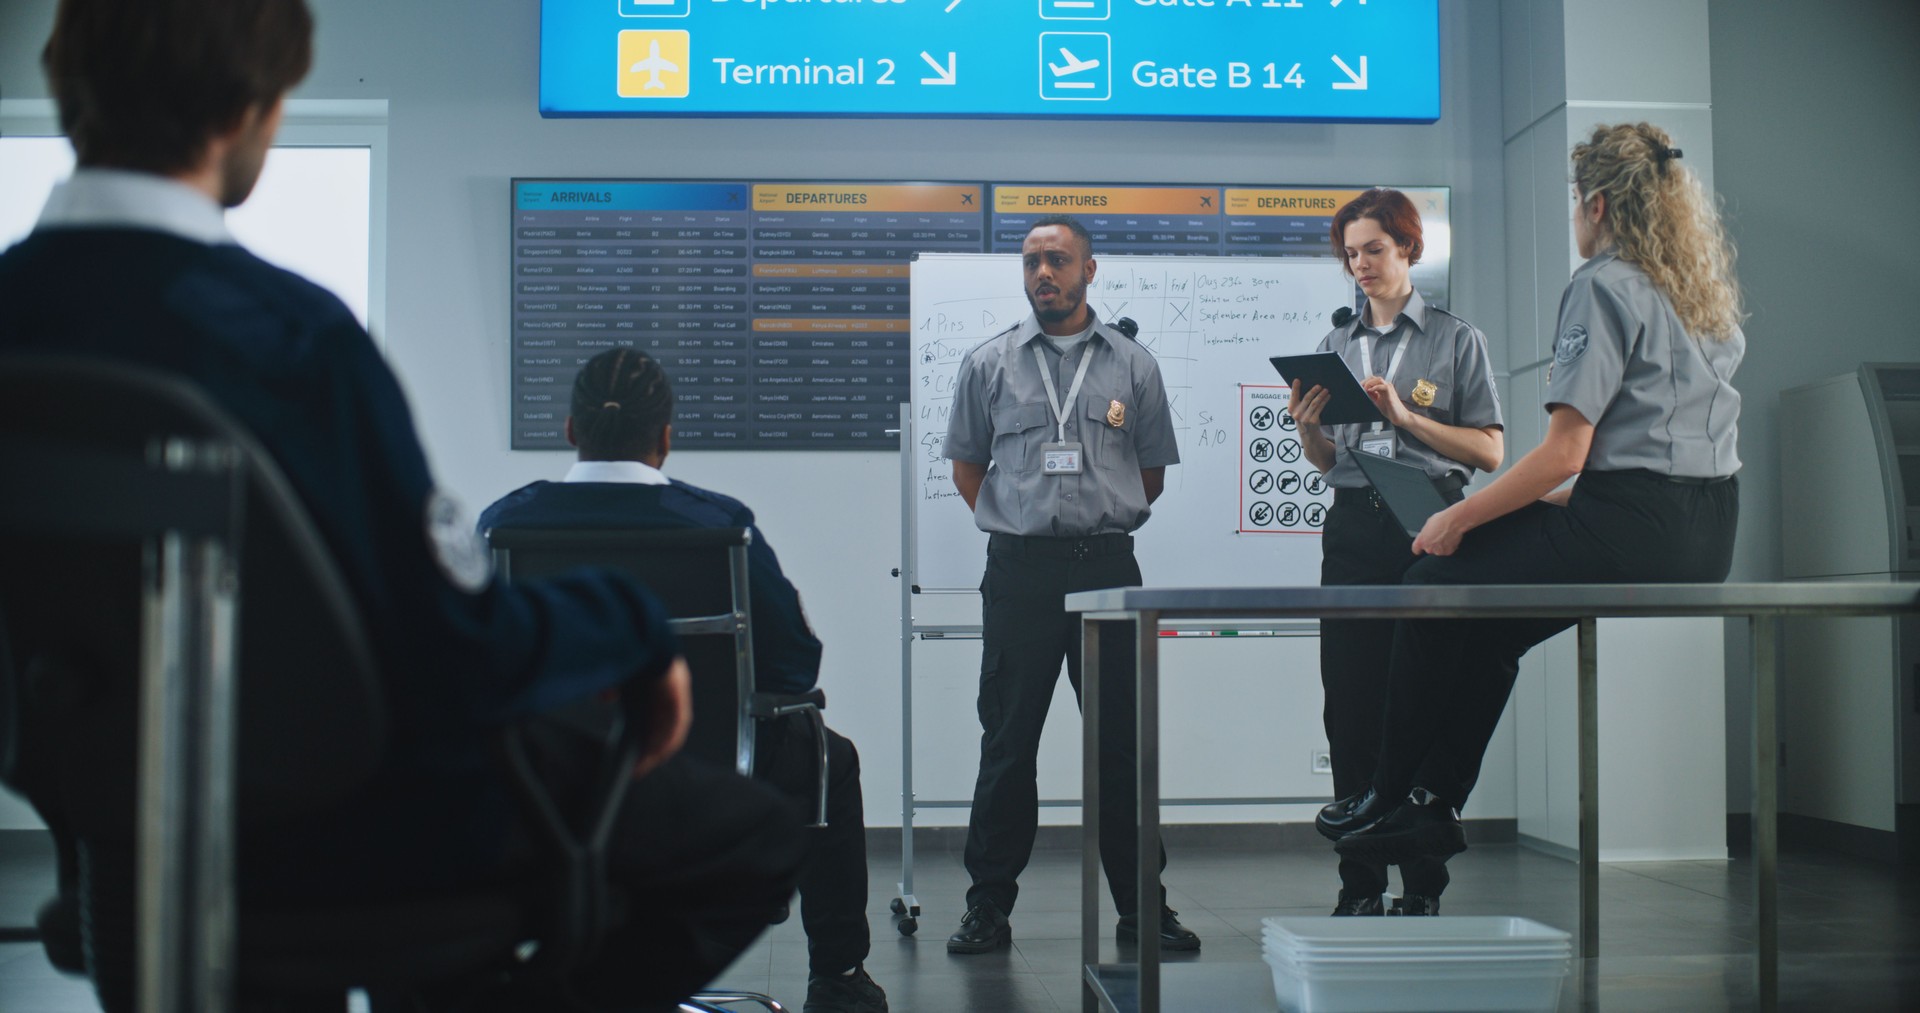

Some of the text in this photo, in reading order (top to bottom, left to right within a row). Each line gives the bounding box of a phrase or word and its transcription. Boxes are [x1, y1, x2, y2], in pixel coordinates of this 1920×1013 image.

[712, 57, 896, 85] Terminal 2
[1131, 60, 1305, 89] Gate B 14
[551, 191, 612, 203] ARRIVALS
[786, 192, 867, 204] DEPARTURES
[1027, 195, 1108, 206] DEPARTURES
[1257, 197, 1336, 209] DEPARTURES
[1187, 234, 1208, 242] Boarding
[713, 285, 736, 293] Boarding
[713, 358, 736, 366] Boarding
